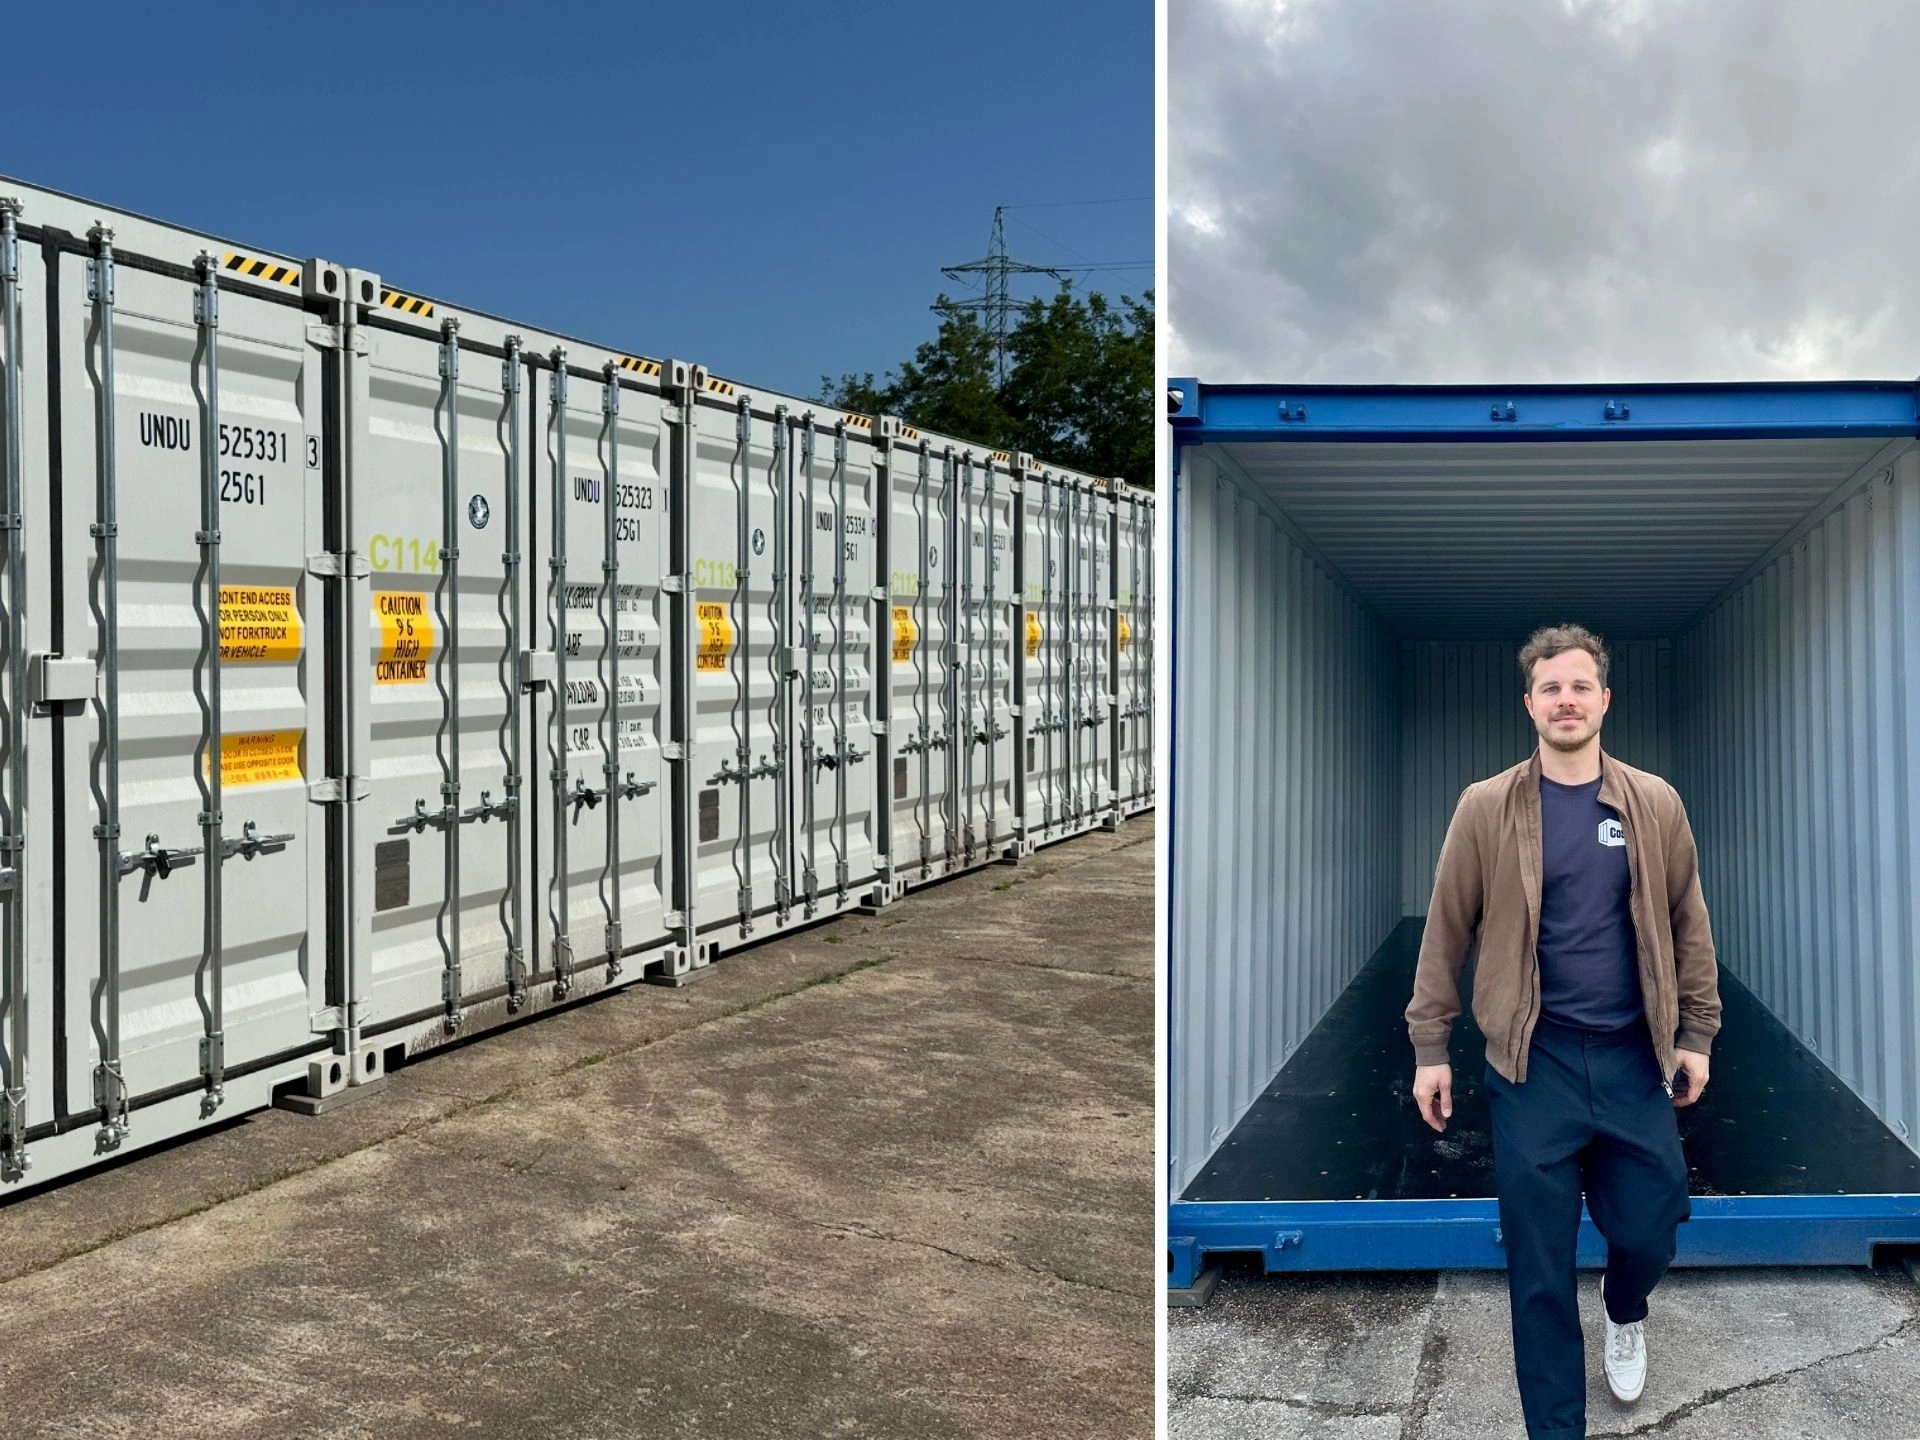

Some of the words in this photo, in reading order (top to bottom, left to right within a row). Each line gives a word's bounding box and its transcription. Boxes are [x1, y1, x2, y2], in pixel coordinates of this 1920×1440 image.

[140, 412, 191, 451] UNDU
[219, 424, 287, 463] 525331
[308, 437, 318, 467] 3
[221, 470, 264, 505] 25G1
[574, 476, 600, 504] UNDU
[617, 484, 652, 509] 525323
[617, 518, 641, 542] 25G1
[846, 514, 866, 535] 25334
[369, 533, 440, 573] C114
[695, 558, 736, 588] C113
[218, 591, 239, 605] RONT
[241, 591, 258, 605] END
[259, 591, 291, 606] ACCESS
[380, 596, 422, 615] CAUTION
[219, 609, 233, 622] OR
[233, 609, 268, 622] PERSON
[267, 610, 289, 622] ONLY
[238, 626, 287, 640] FORKTRUCK
[231, 645, 267, 658] VEHICLE
[393, 639, 420, 659] HIGH
[564, 633, 582, 656] ARE
[376, 660, 426, 681] CONTAINER
[565, 681, 598, 704] AYLOAD
[238, 734, 276, 746] WARNING
